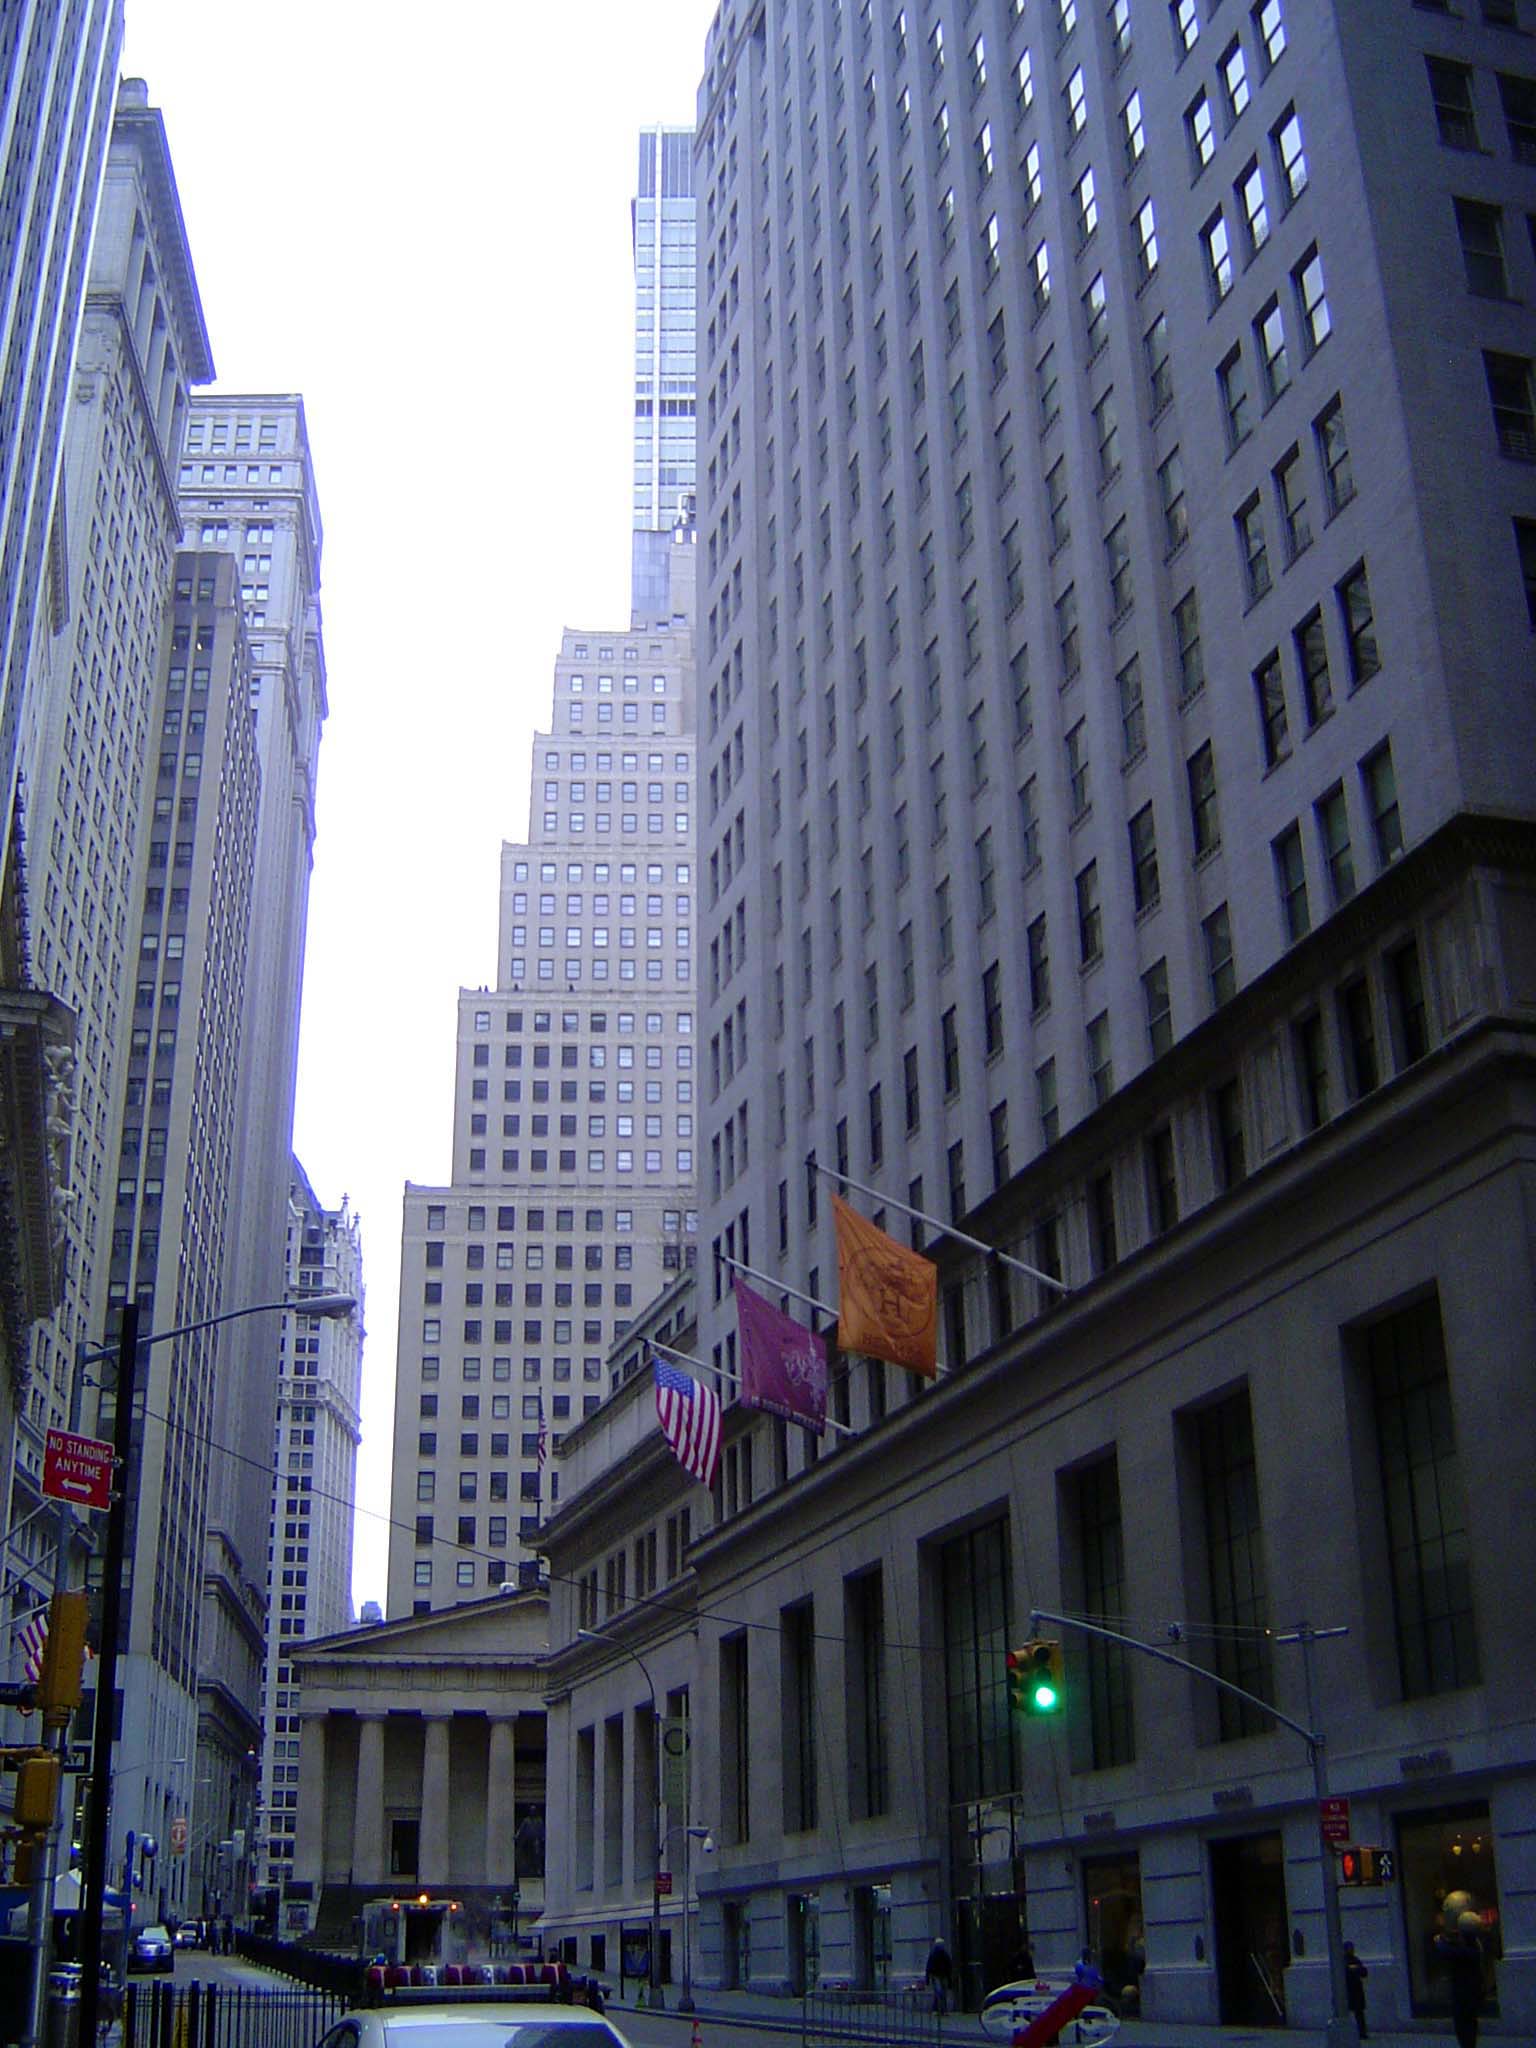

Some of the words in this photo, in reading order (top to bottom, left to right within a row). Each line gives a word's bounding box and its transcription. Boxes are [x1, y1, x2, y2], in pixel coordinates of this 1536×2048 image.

[49, 1435, 63, 1451] NO
[66, 1440, 110, 1463] STANDING
[55, 1457, 102, 1480] ANYTIME
